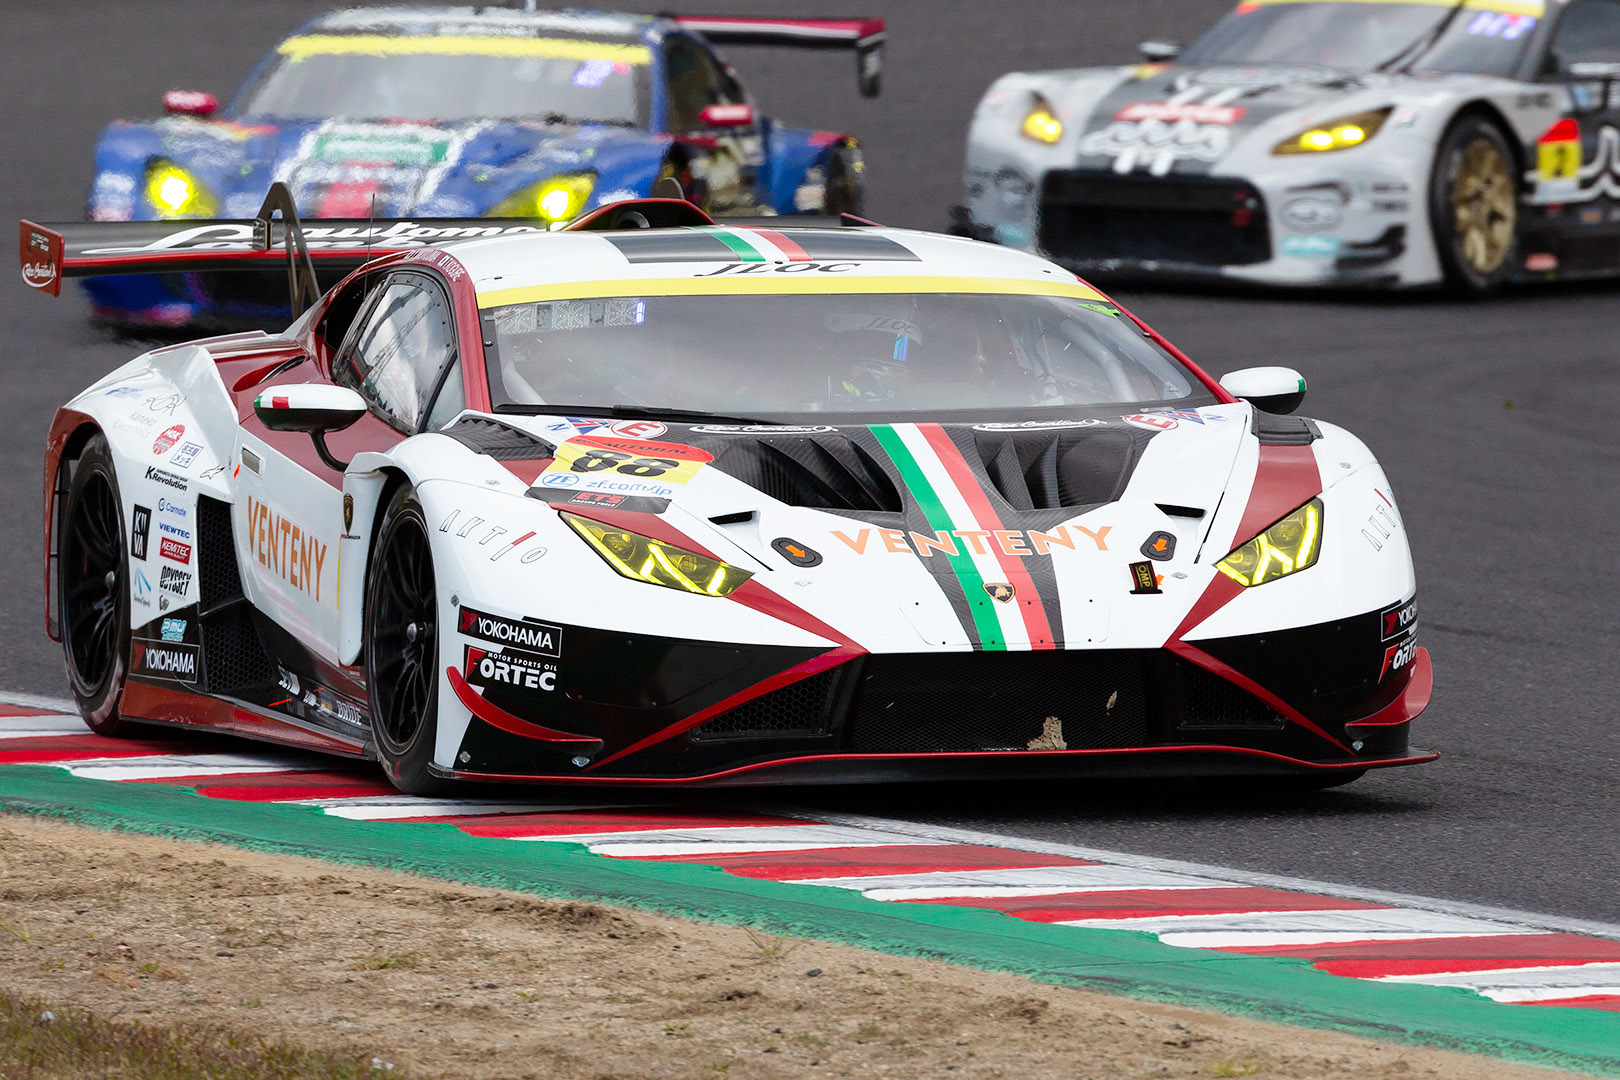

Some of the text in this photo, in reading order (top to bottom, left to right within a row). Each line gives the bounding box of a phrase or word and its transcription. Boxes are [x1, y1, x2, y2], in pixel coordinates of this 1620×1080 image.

[693, 262, 862, 277] JLOC
[570, 449, 680, 477] 88
[546, 473, 572, 484] ZF
[576, 491, 625, 504] ETS
[159, 522, 190, 539] VIEWTEC
[829, 525, 1113, 556] VENTENY
[162, 539, 191, 556] KEMITEC
[249, 495, 327, 602] VENTENY
[1138, 565, 1151, 587] OMP
[478, 617, 554, 650] YOKOHAMA
[146, 647, 195, 674] YOKOHAMA
[487, 651, 558, 672] MOTOR SPORTS OIL
[336, 700, 362, 725] BRIDE
